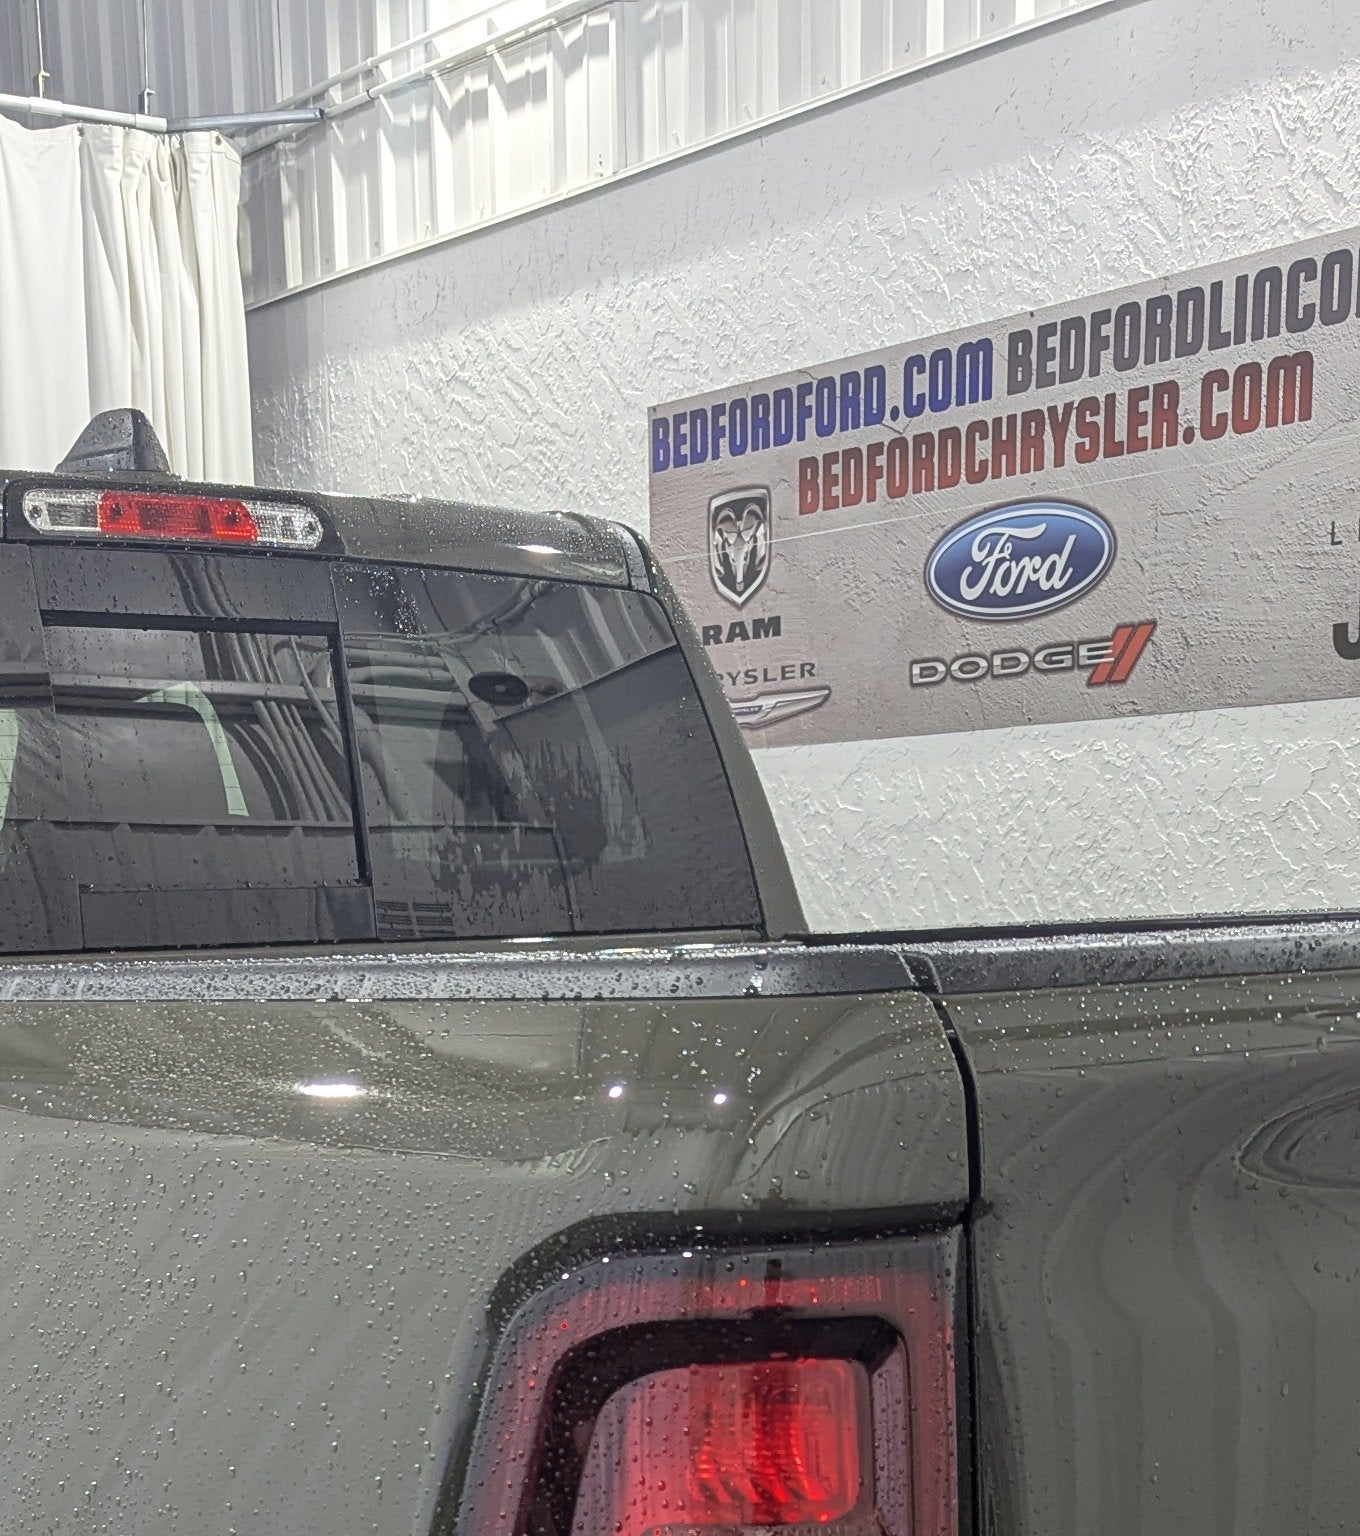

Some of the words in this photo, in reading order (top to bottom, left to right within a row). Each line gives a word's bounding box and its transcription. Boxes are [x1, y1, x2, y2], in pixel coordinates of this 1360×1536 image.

[651, 336, 994, 474] BEDFORDFORD.COM
[797, 350, 1314, 517] BEDFORDCHRYSLER.COM
[958, 522, 1078, 601] Ford
[701, 614, 782, 647] RAM
[910, 640, 1116, 686] DODGE
